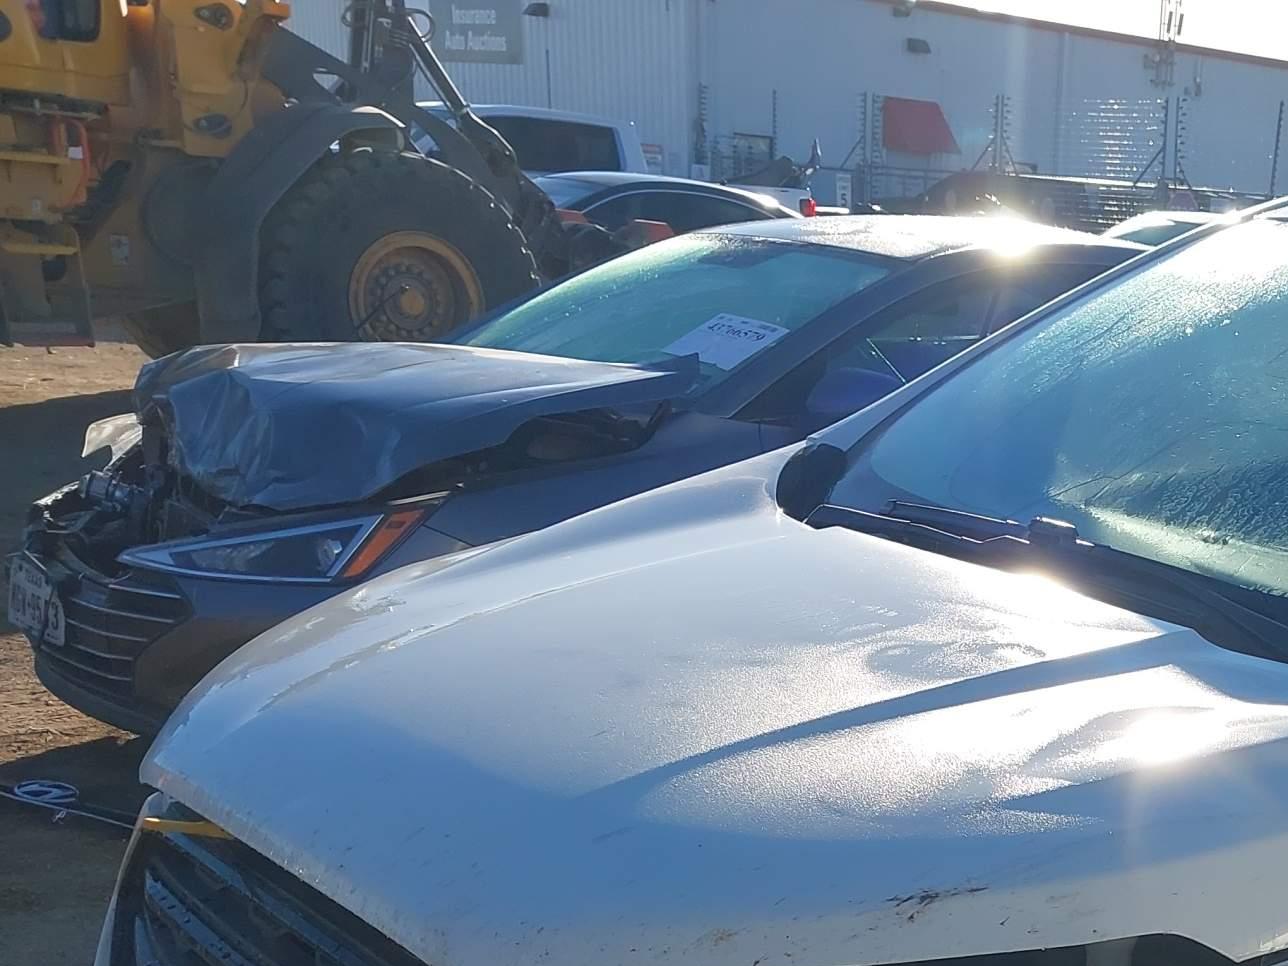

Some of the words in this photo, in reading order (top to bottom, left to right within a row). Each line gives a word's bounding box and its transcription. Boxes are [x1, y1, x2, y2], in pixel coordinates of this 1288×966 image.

[451, 4, 497, 25] Insurance
[445, 30, 465, 50] Auto
[467, 30, 507, 51] Auctions
